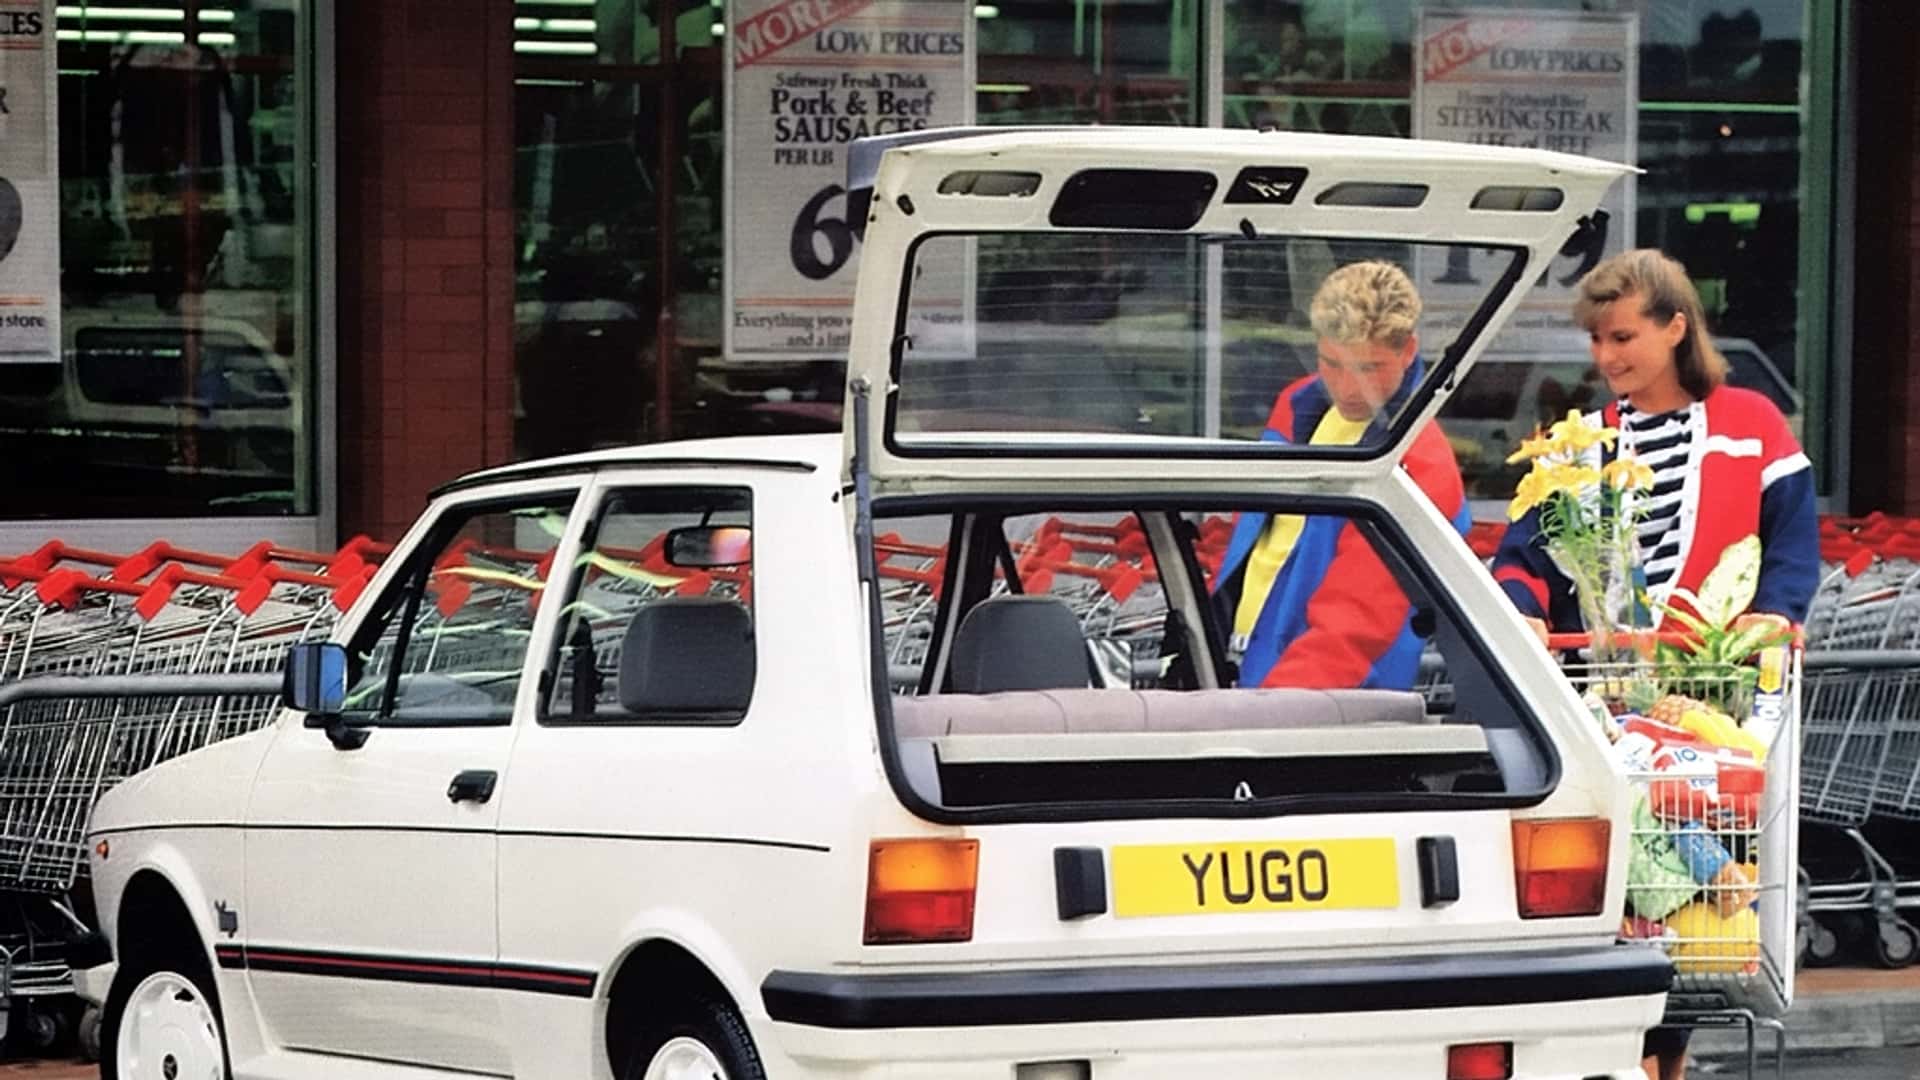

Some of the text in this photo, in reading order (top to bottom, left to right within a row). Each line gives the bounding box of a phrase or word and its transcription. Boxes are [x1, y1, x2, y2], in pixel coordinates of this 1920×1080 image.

[816, 29, 963, 55] LOW PRICES
[1490, 47, 1624, 73] LOW PRICES
[776, 72, 927, 91] Safeway Fresh Thick
[770, 88, 936, 116] Pork & Beef
[1437, 106, 1612, 133] STEWING STEAK
[774, 149, 834, 166] PER LB
[6, 313, 47, 328] store
[734, 312, 815, 330] Everything
[816, 316, 844, 330] you
[1182, 848, 1329, 907] YUGO
